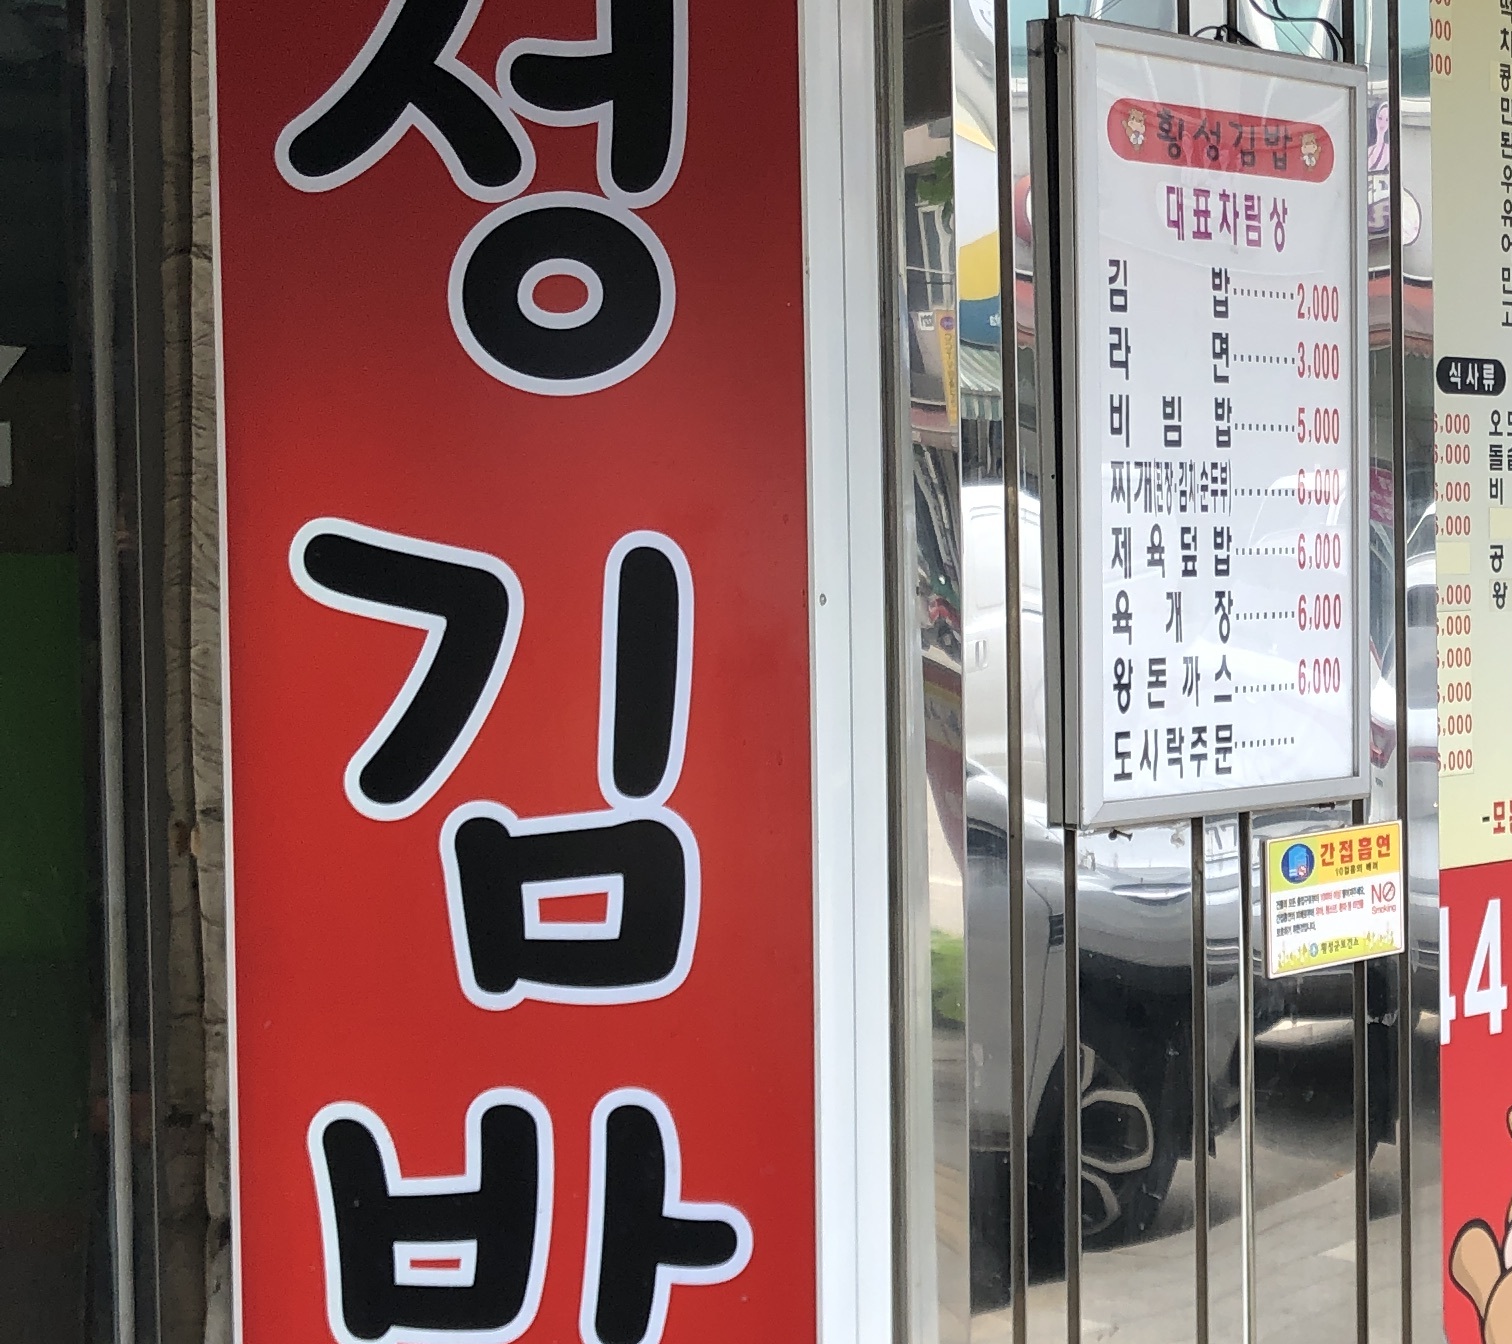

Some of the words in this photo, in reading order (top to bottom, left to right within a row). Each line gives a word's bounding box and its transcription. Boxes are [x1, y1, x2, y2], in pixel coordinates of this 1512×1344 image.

[1156, 106, 1293, 171] 횡성김밥
[1165, 184, 1289, 253] 대표차림상
[1297, 282, 1339, 323] 2,000
[1297, 341, 1340, 381] 3,000
[1448, 361, 1495, 392] 식사류
[1297, 407, 1340, 444] 5,000
[1297, 468, 1340, 506] 6,000
[1111, 523, 1232, 579] 제육덮밥
[1297, 533, 1341, 570] 6,000
[1298, 593, 1342, 631] 6,000
[1112, 654, 1232, 714] 왕돈까스
[1298, 657, 1341, 695] 6,000
[1113, 724, 1233, 782] 도시락주문
[1320, 833, 1391, 867] 간접흡연
[1371, 904, 1397, 916] Smoking
